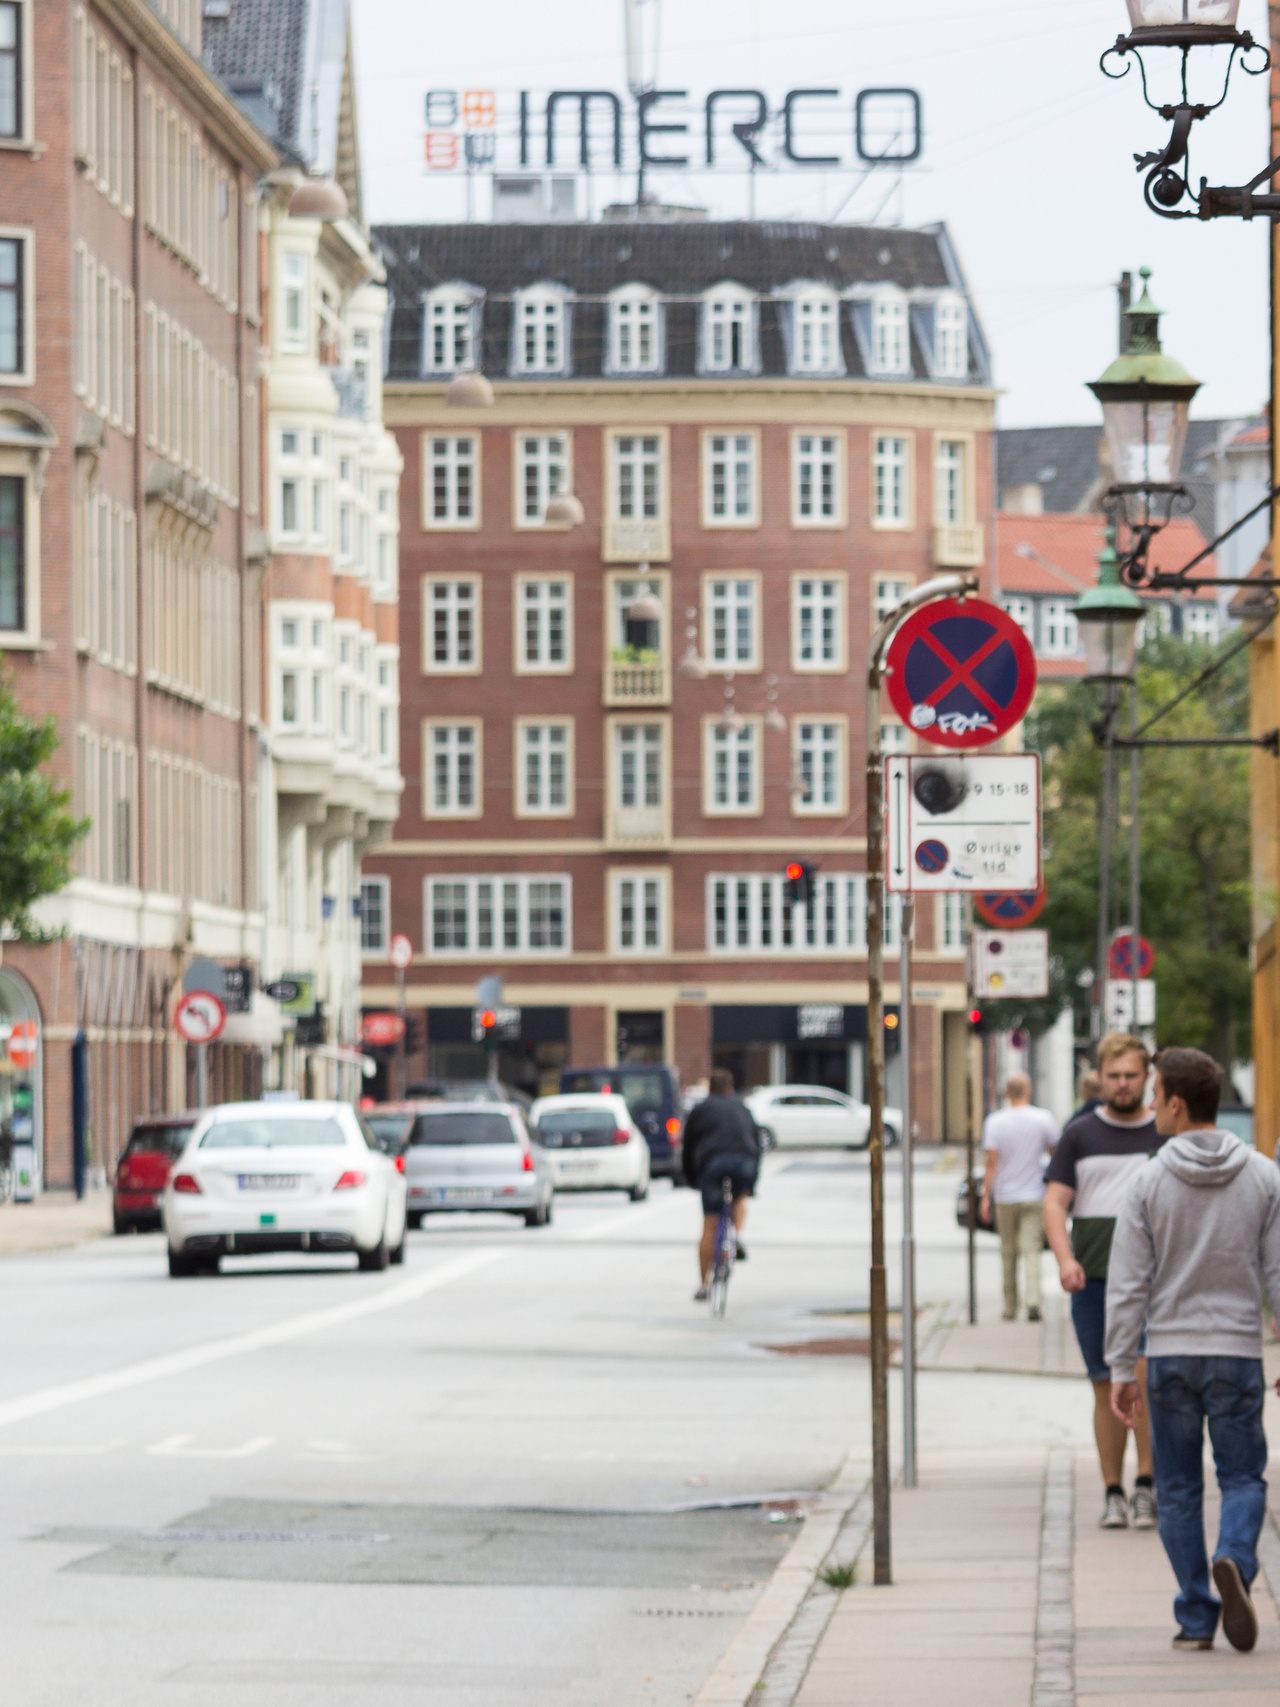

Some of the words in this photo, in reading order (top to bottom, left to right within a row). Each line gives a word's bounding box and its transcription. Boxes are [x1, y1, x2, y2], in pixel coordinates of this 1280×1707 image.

[519, 88, 922, 165] IMERCO
[965, 841, 1022, 856] Øvrige
[983, 861, 1006, 873] tid
